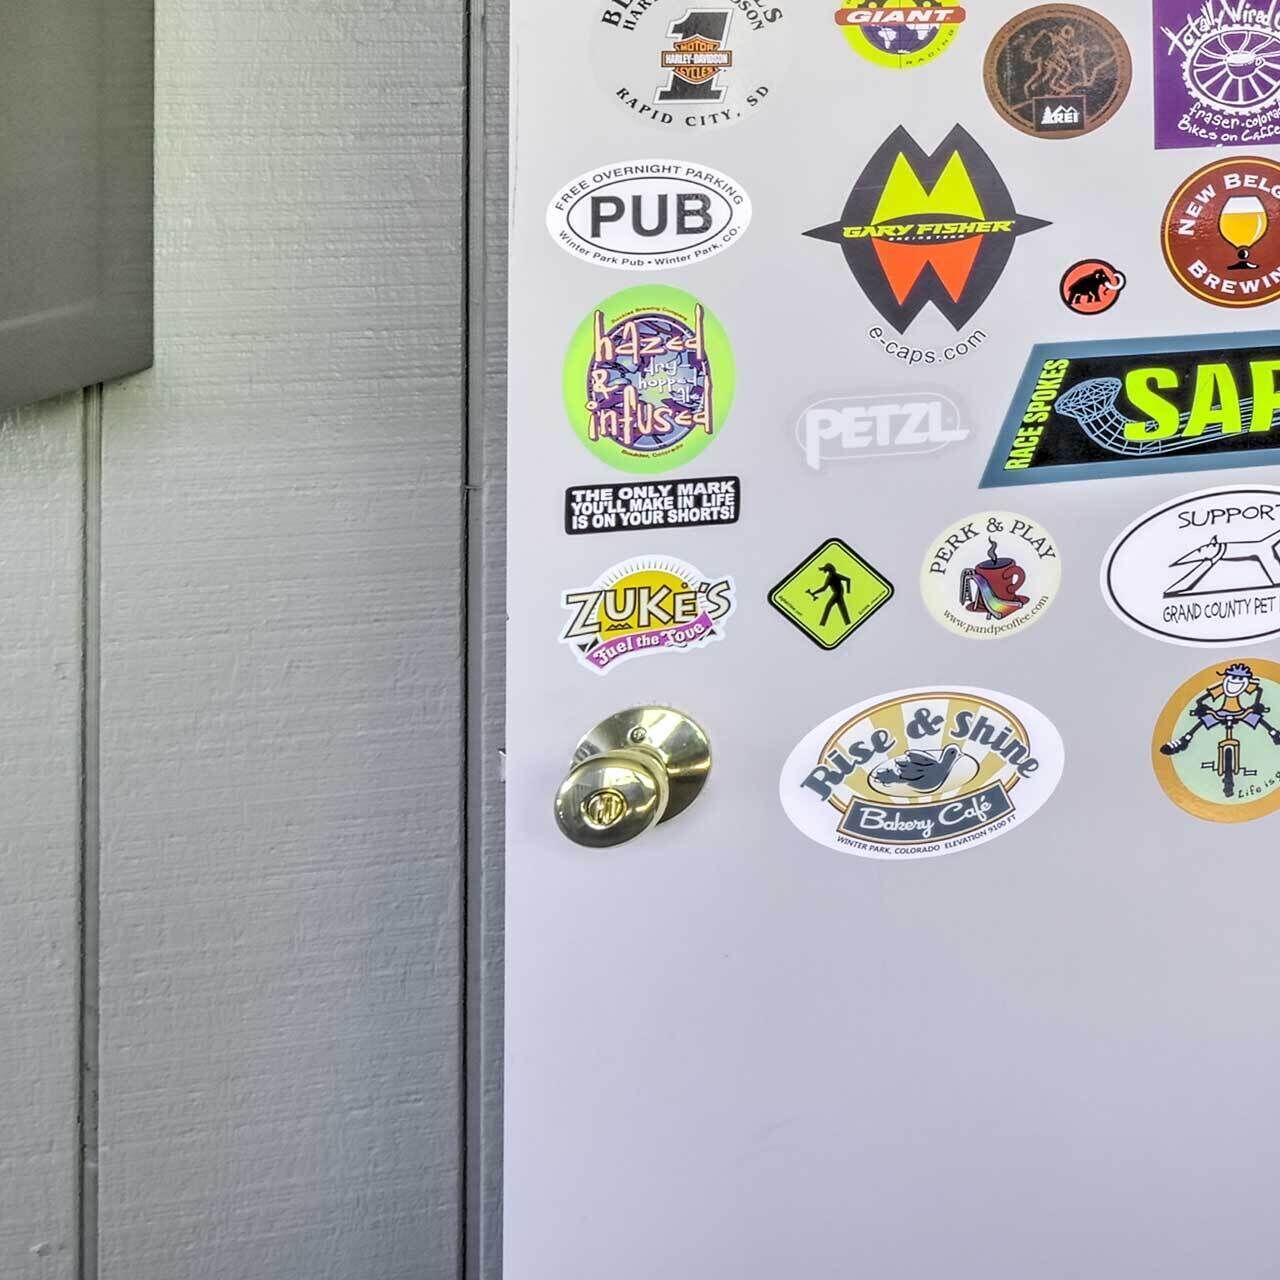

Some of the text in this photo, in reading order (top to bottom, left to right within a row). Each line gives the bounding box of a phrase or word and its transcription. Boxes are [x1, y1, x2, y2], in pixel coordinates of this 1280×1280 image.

[846, 9, 954, 23] GIANT
[616, 86, 769, 124] RAPID SD
[555, 164, 744, 212] FREE OVERNIGHT PARKING
[590, 193, 713, 239] PUB
[842, 220, 1015, 238] GARY FISHER
[1178, 184, 1217, 237] NEW
[558, 230, 692, 266] Winter Park Pub Winter
[869, 326, 988, 365] e-caps.com
[586, 375, 713, 445] infused
[1004, 358, 1070, 471] RACE SPOKES
[806, 401, 970, 470] PETZL
[571, 493, 735, 515] YOU'LL MAKE IN LIFE
[572, 480, 736, 503] THE ONLY MARK
[572, 506, 735, 530] IS ON YOUR SHORTS!
[929, 517, 1056, 575] PERK & PLAY
[943, 595, 1049, 635] www.pandpcoffee.com
[1163, 603, 1202, 624] GRAND
[1204, 598, 1253, 619] COUNTY
[1254, 596, 1276, 614] PET
[593, 634, 660, 666] Fuel the
[800, 708, 1039, 802] Rise & Shine
[858, 796, 992, 838] Bakery Café
[837, 830, 987, 855] WINTER COLORADO ELEVATION
